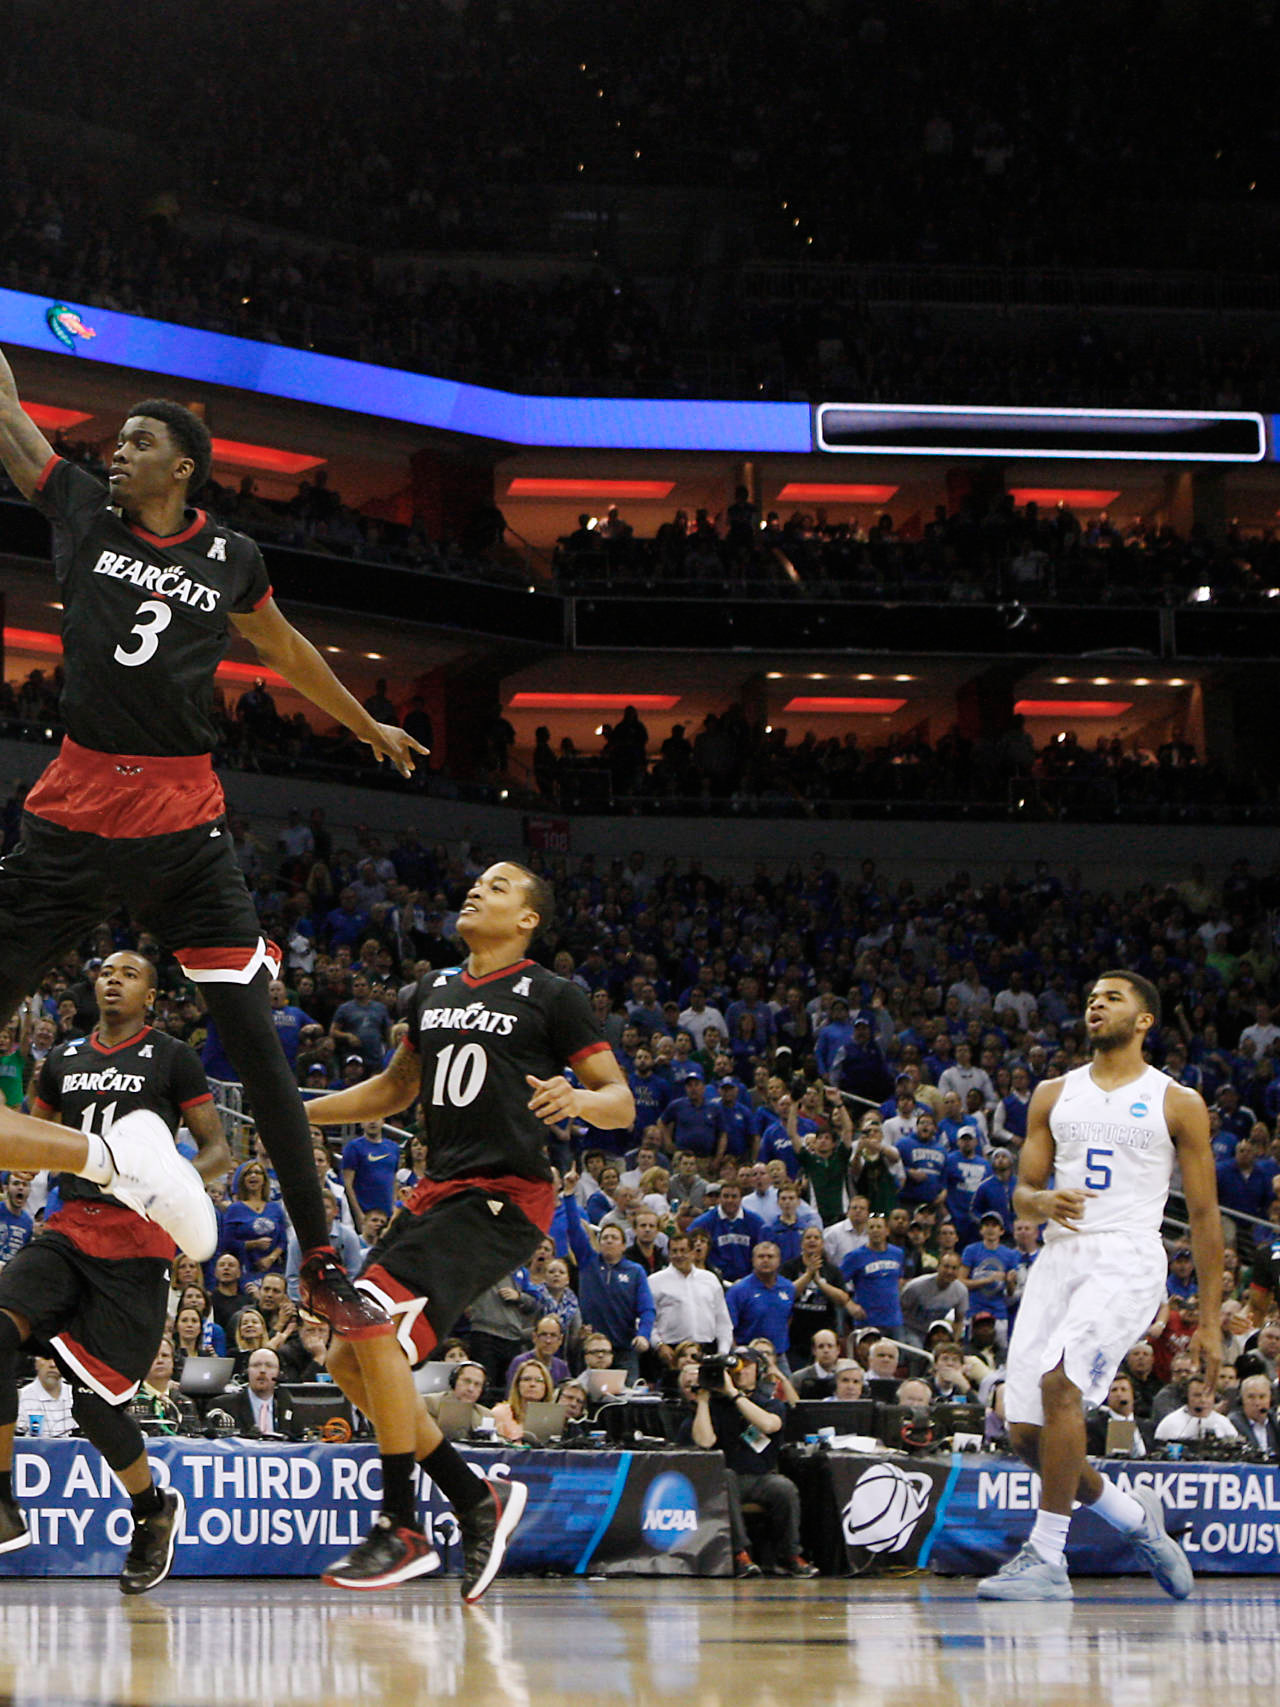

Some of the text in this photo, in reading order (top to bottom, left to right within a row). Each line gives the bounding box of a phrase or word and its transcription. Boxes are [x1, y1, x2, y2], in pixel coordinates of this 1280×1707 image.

[93, 551, 220, 612] BEARCATS
[114, 600, 172, 667] 3
[420, 1002, 518, 1035] BEARCATS
[62, 1067, 145, 1093] BEARCATS
[432, 1043, 487, 1107] 10
[81, 1101, 118, 1134] 11
[1057, 1121, 1153, 1150] KENTUCKY
[1085, 1148, 1114, 1190] 5
[182, 1456, 321, 1500] THIRD
[105, 1509, 135, 1545] O
[177, 1508, 381, 1545] LOUISVILL
[642, 1509, 698, 1530] NCAA
[1184, 1522, 1280, 1554] LOUIS
